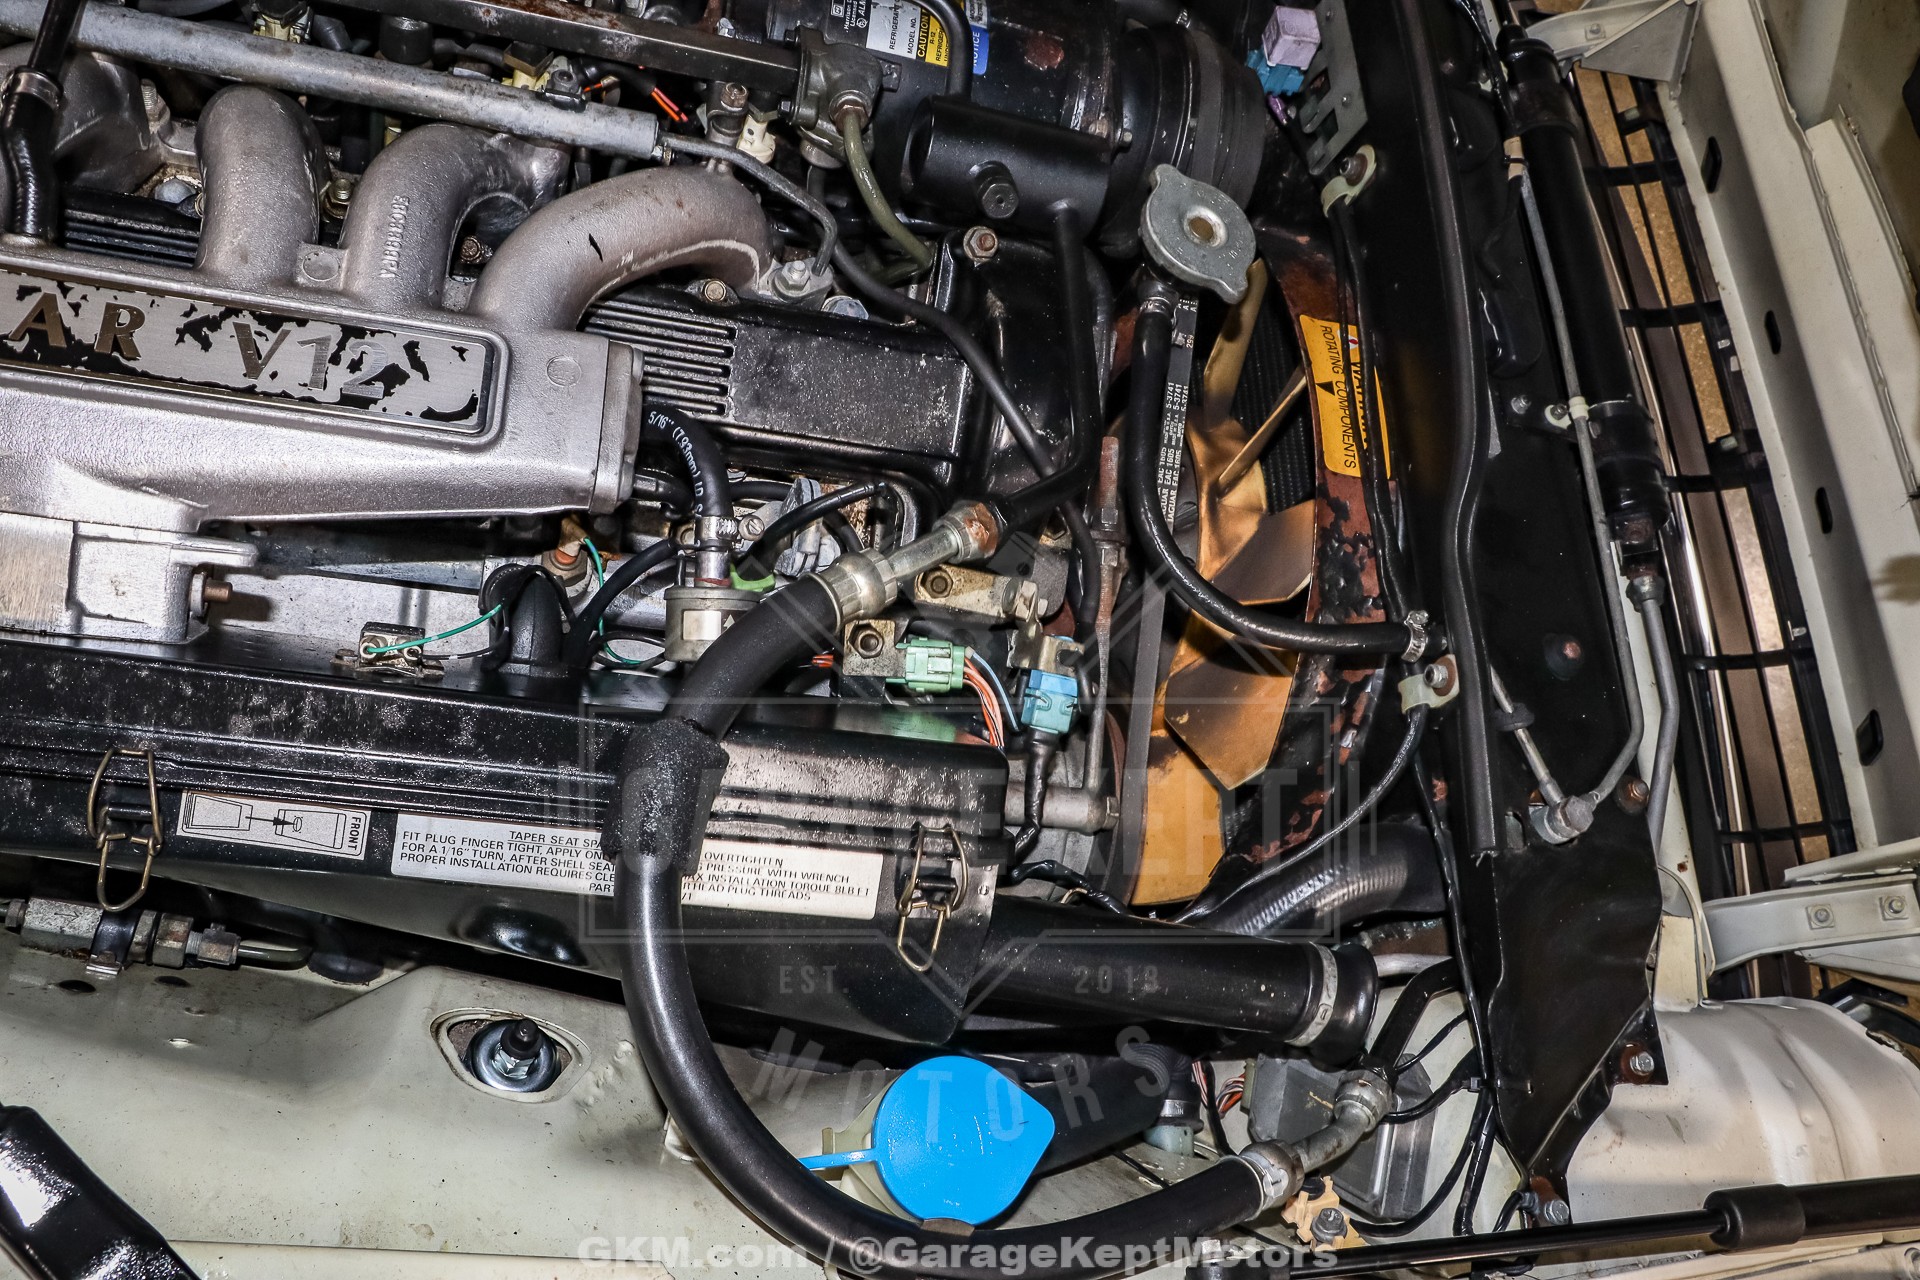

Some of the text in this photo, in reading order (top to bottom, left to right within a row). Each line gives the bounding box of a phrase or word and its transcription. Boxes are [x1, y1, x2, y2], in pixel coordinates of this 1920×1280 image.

[907, 30, 916, 54] MODEL
[917, 15, 929, 57] CAUTION
[232, 320, 391, 400] V12
[1166, 382, 1175, 409] 5-3741
[1173, 384, 1182, 411] 5-3741
[1320, 325, 1357, 469] ROTATING COMPONENTS
[1167, 448, 1175, 467] 1605
[1164, 469, 1173, 486] EAC
[348, 816, 362, 851] FRONT
[508, 830, 546, 844] TAPER
[551, 835, 580, 847] SEAT
[704, 851, 784, 868] OVERTIGHTEN
[400, 852, 447, 865] PROPER
[449, 857, 532, 874] INSTALLATION
[536, 866, 592, 881] REQUIRES
[728, 885, 756, 896] PLUG
[760, 888, 811, 901] THREADS
[401, 841, 425, 852] FOR
[429, 844, 437, 854] A
[509, 854, 548, 865] AFTER
[550, 858, 585, 870] SHELL
[708, 873, 786, 890] INSTALLATION
[402, 831, 421, 841] FIT
[425, 833, 456, 845] PLUG
[461, 837, 504, 850] FINGER
[508, 842, 542, 855] TIGHT,
[546, 847, 582, 858] APPLY
[706, 862, 762, 876] PRESSURE
[767, 869, 798, 879] WITH
[801, 871, 850, 884] WRENCH
